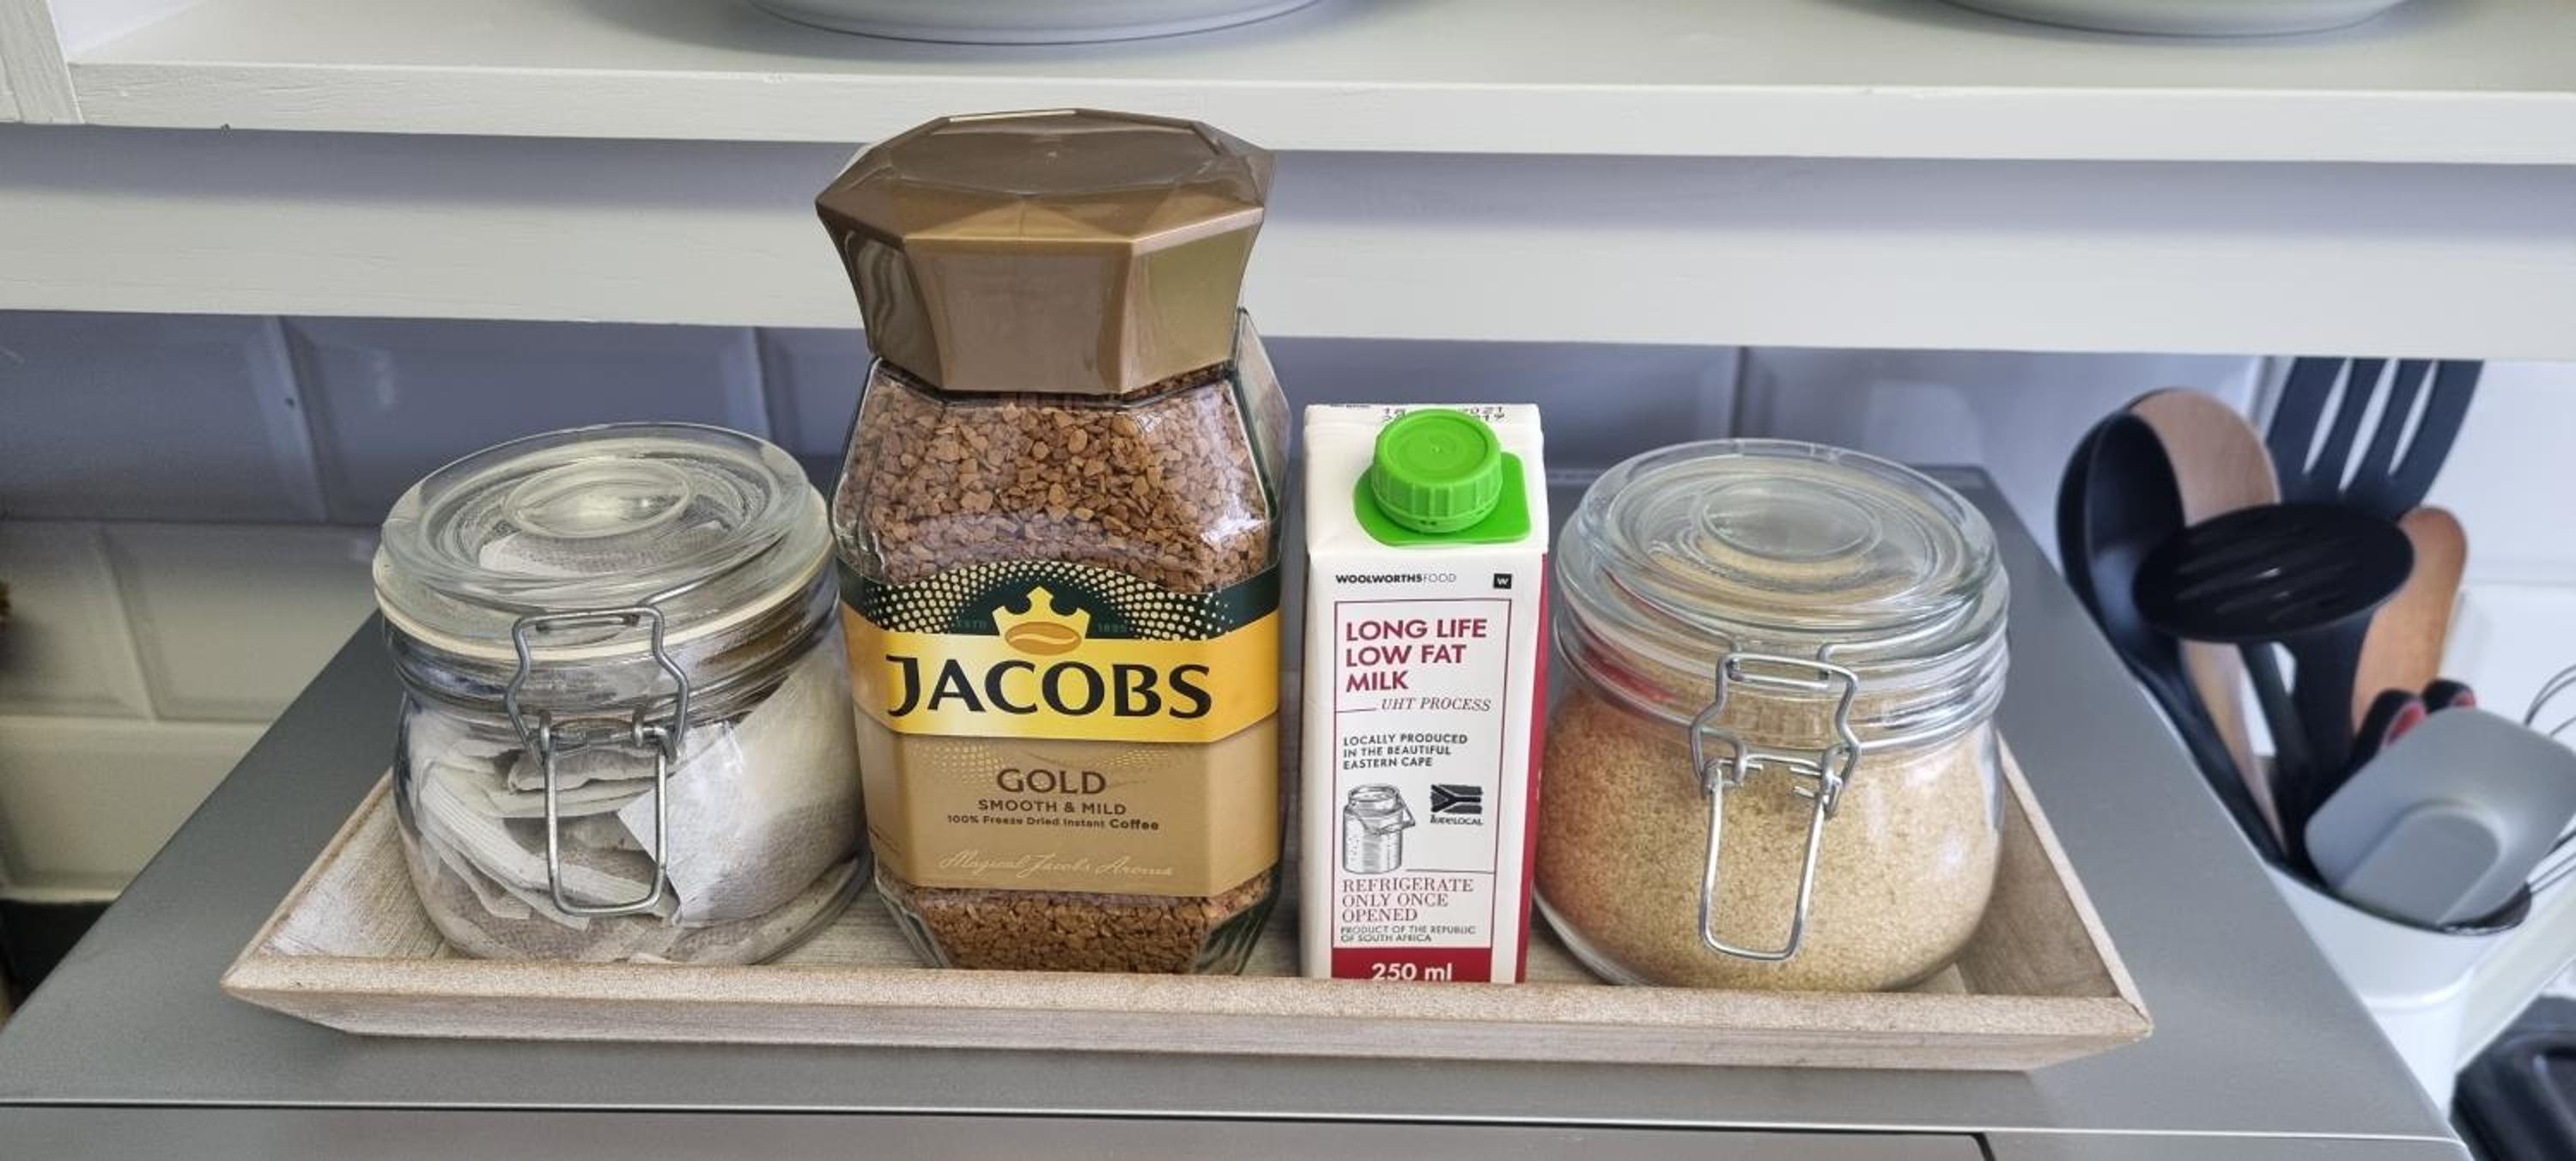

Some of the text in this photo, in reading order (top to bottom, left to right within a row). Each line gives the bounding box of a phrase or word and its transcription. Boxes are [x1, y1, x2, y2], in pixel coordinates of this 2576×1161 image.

[1346, 618, 1488, 642] LONG LIFE
[1346, 644, 1467, 668] LOW FAT
[886, 655, 1212, 720] JACOBS
[1346, 671, 1409, 693] MILK
[1381, 697, 1492, 712] UHT PROCESS
[1343, 733, 1468, 746] LOCALLY PRODUCED
[1343, 745, 1451, 758] IN THE BEAUTIFUL
[1343, 757, 1433, 770] EASTERN CAPE
[996, 769, 1107, 795] GOLD
[978, 799, 1127, 816] SMOOTH & MILD
[948, 814, 1159, 831] 100% Freeze Dried Instant Coffee
[1343, 878, 1473, 892] REFRIGERATE
[1342, 892, 1449, 909] ONLY ONCE
[1342, 908, 1419, 923] OPENED
[1340, 925, 1476, 935] PRODUCT OF THE REPUBLIC
[1358, 933, 1394, 942] SOUTH
[1395, 933, 1432, 942] AFRICA
[1371, 962, 1453, 981] 250 ml
